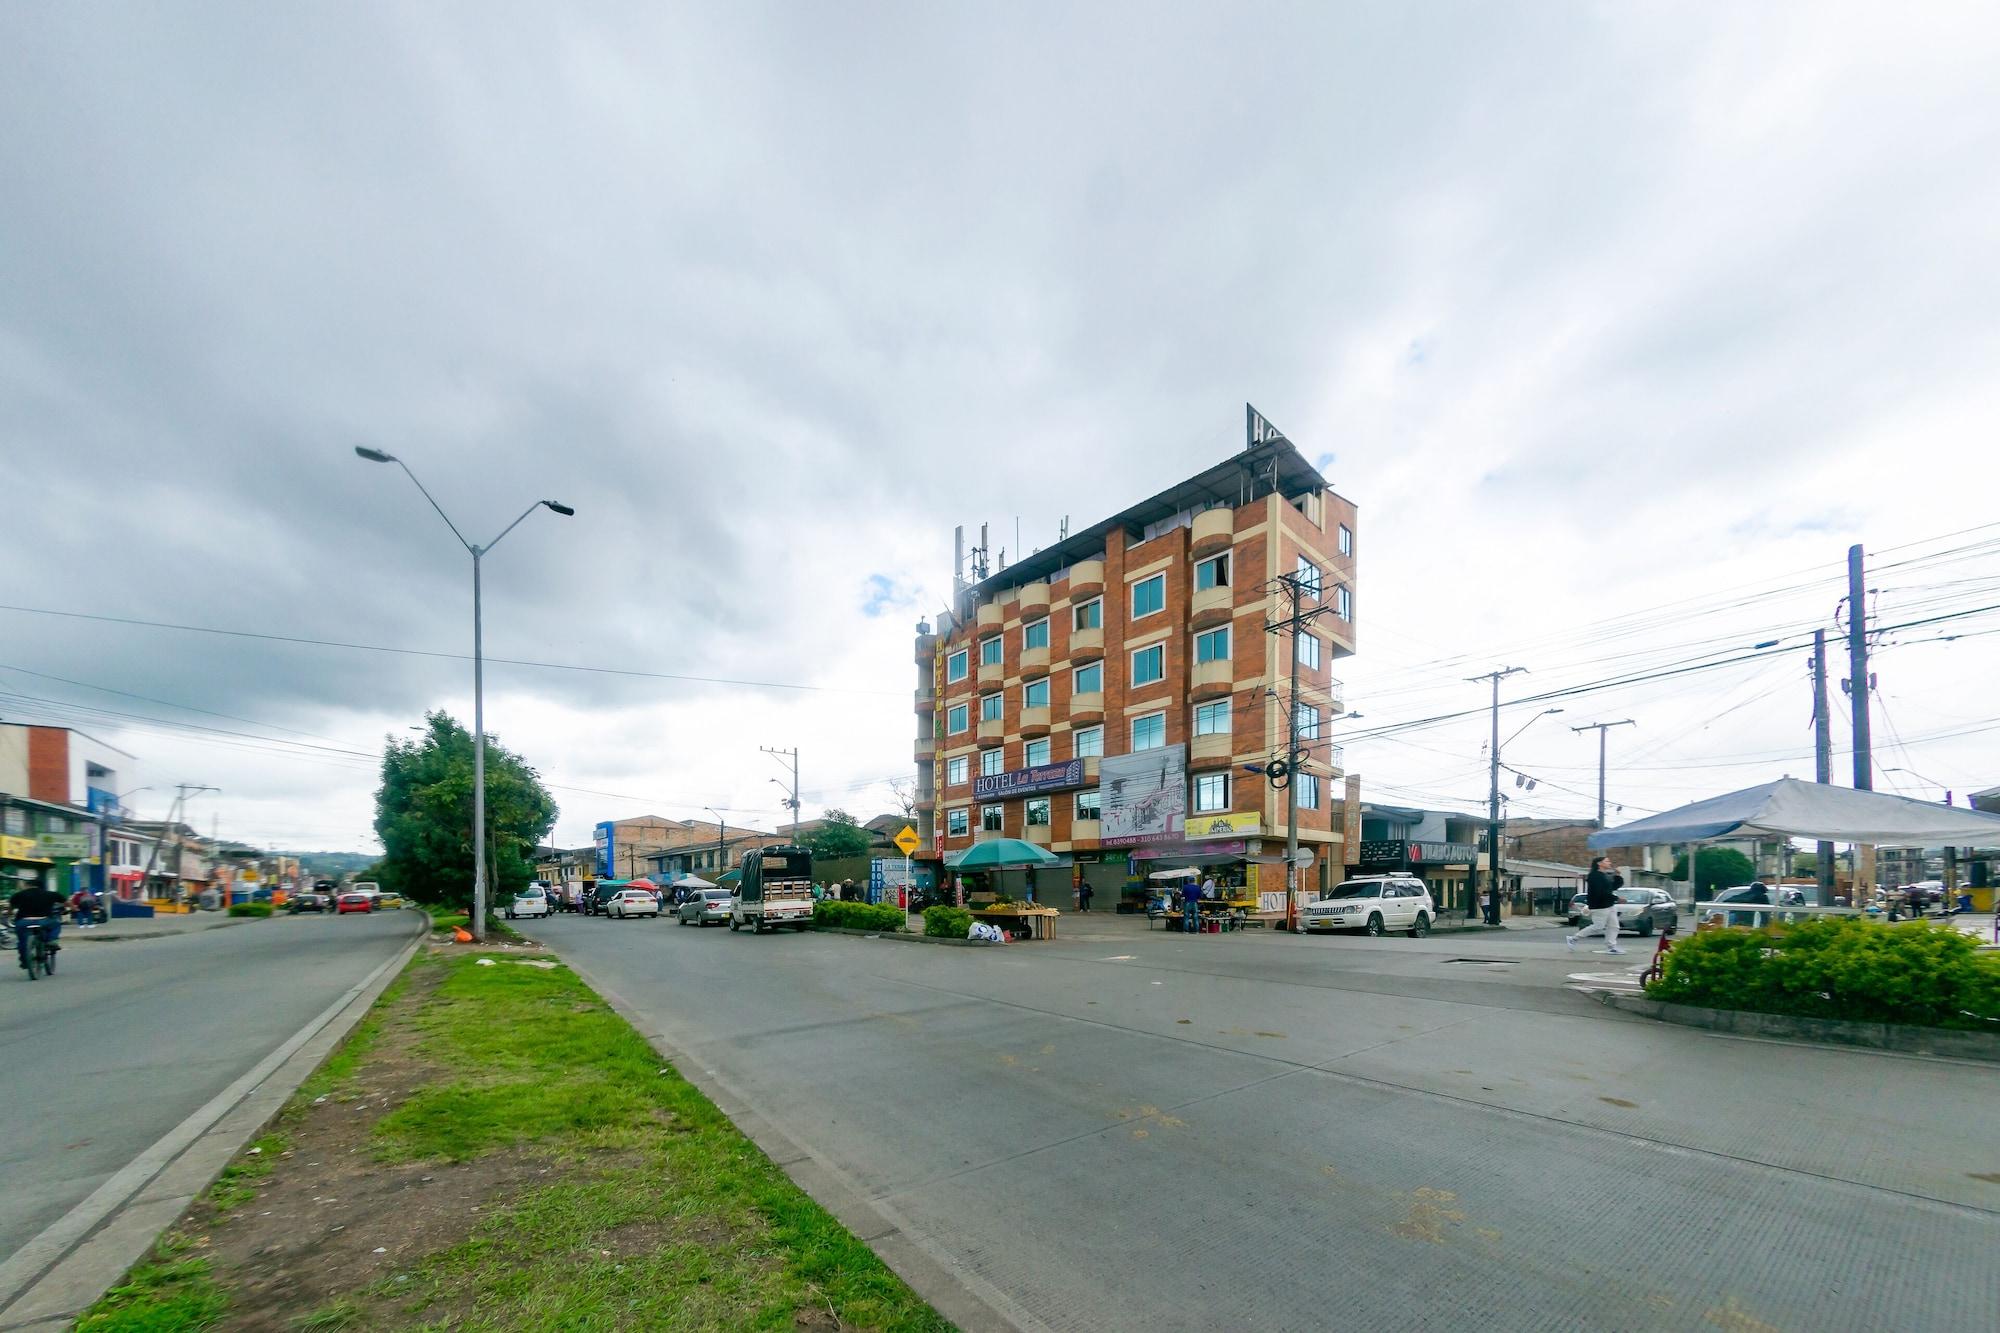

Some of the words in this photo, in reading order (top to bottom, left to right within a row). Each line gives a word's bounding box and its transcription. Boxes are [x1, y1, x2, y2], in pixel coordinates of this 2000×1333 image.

[935, 749, 944, 819] HORAS
[977, 773, 1015, 793] HOTEL
[1263, 892, 1304, 910] HOTL
